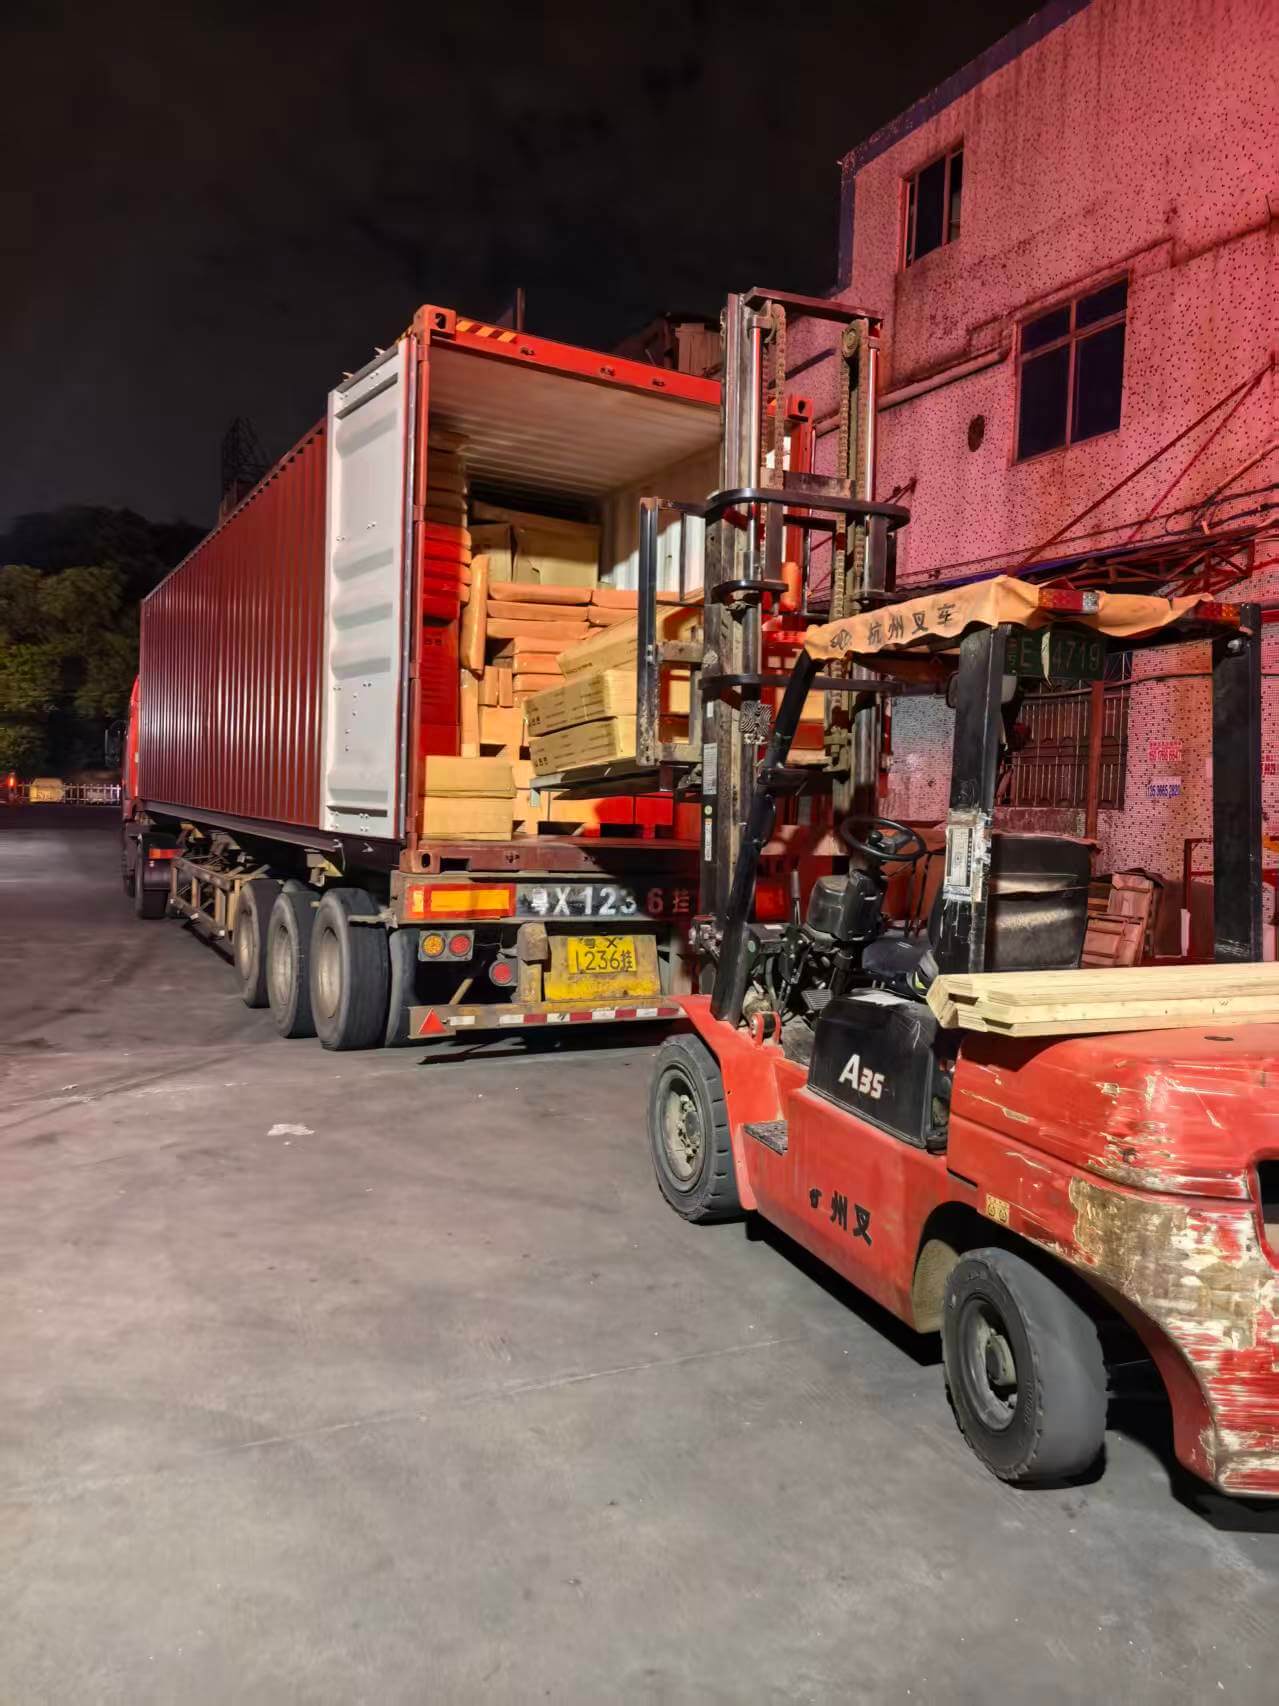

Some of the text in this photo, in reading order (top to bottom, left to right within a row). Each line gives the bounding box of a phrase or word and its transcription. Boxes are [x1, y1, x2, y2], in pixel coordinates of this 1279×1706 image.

[868, 603, 956, 646] 杭州叉车
[575, 949, 633, 971] 1236挂
[838, 1053, 886, 1100] A35
